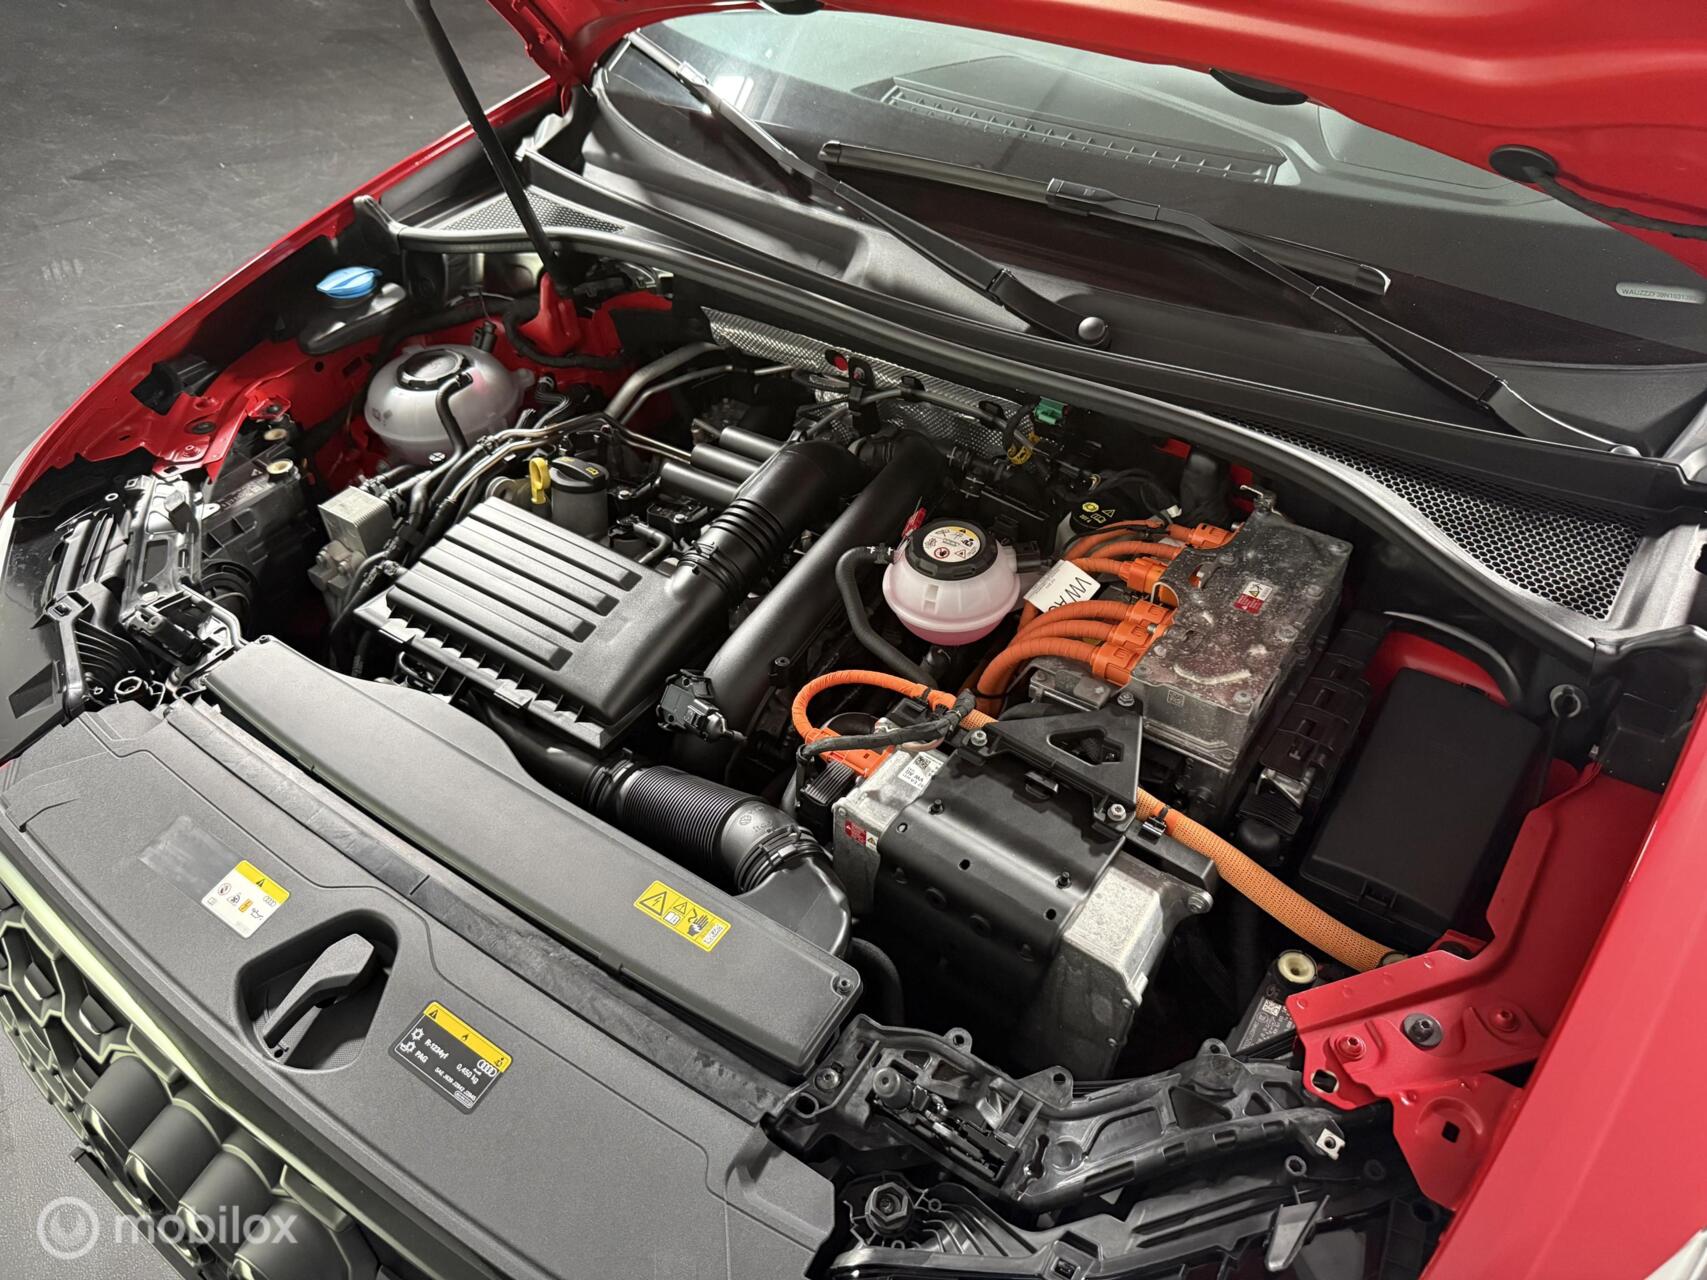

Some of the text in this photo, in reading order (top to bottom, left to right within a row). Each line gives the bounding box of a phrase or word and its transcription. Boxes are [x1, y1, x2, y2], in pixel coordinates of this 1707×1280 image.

[414, 1050, 429, 1063] PAG
[424, 1038, 479, 1085] R-1234yf 0,450 kg
